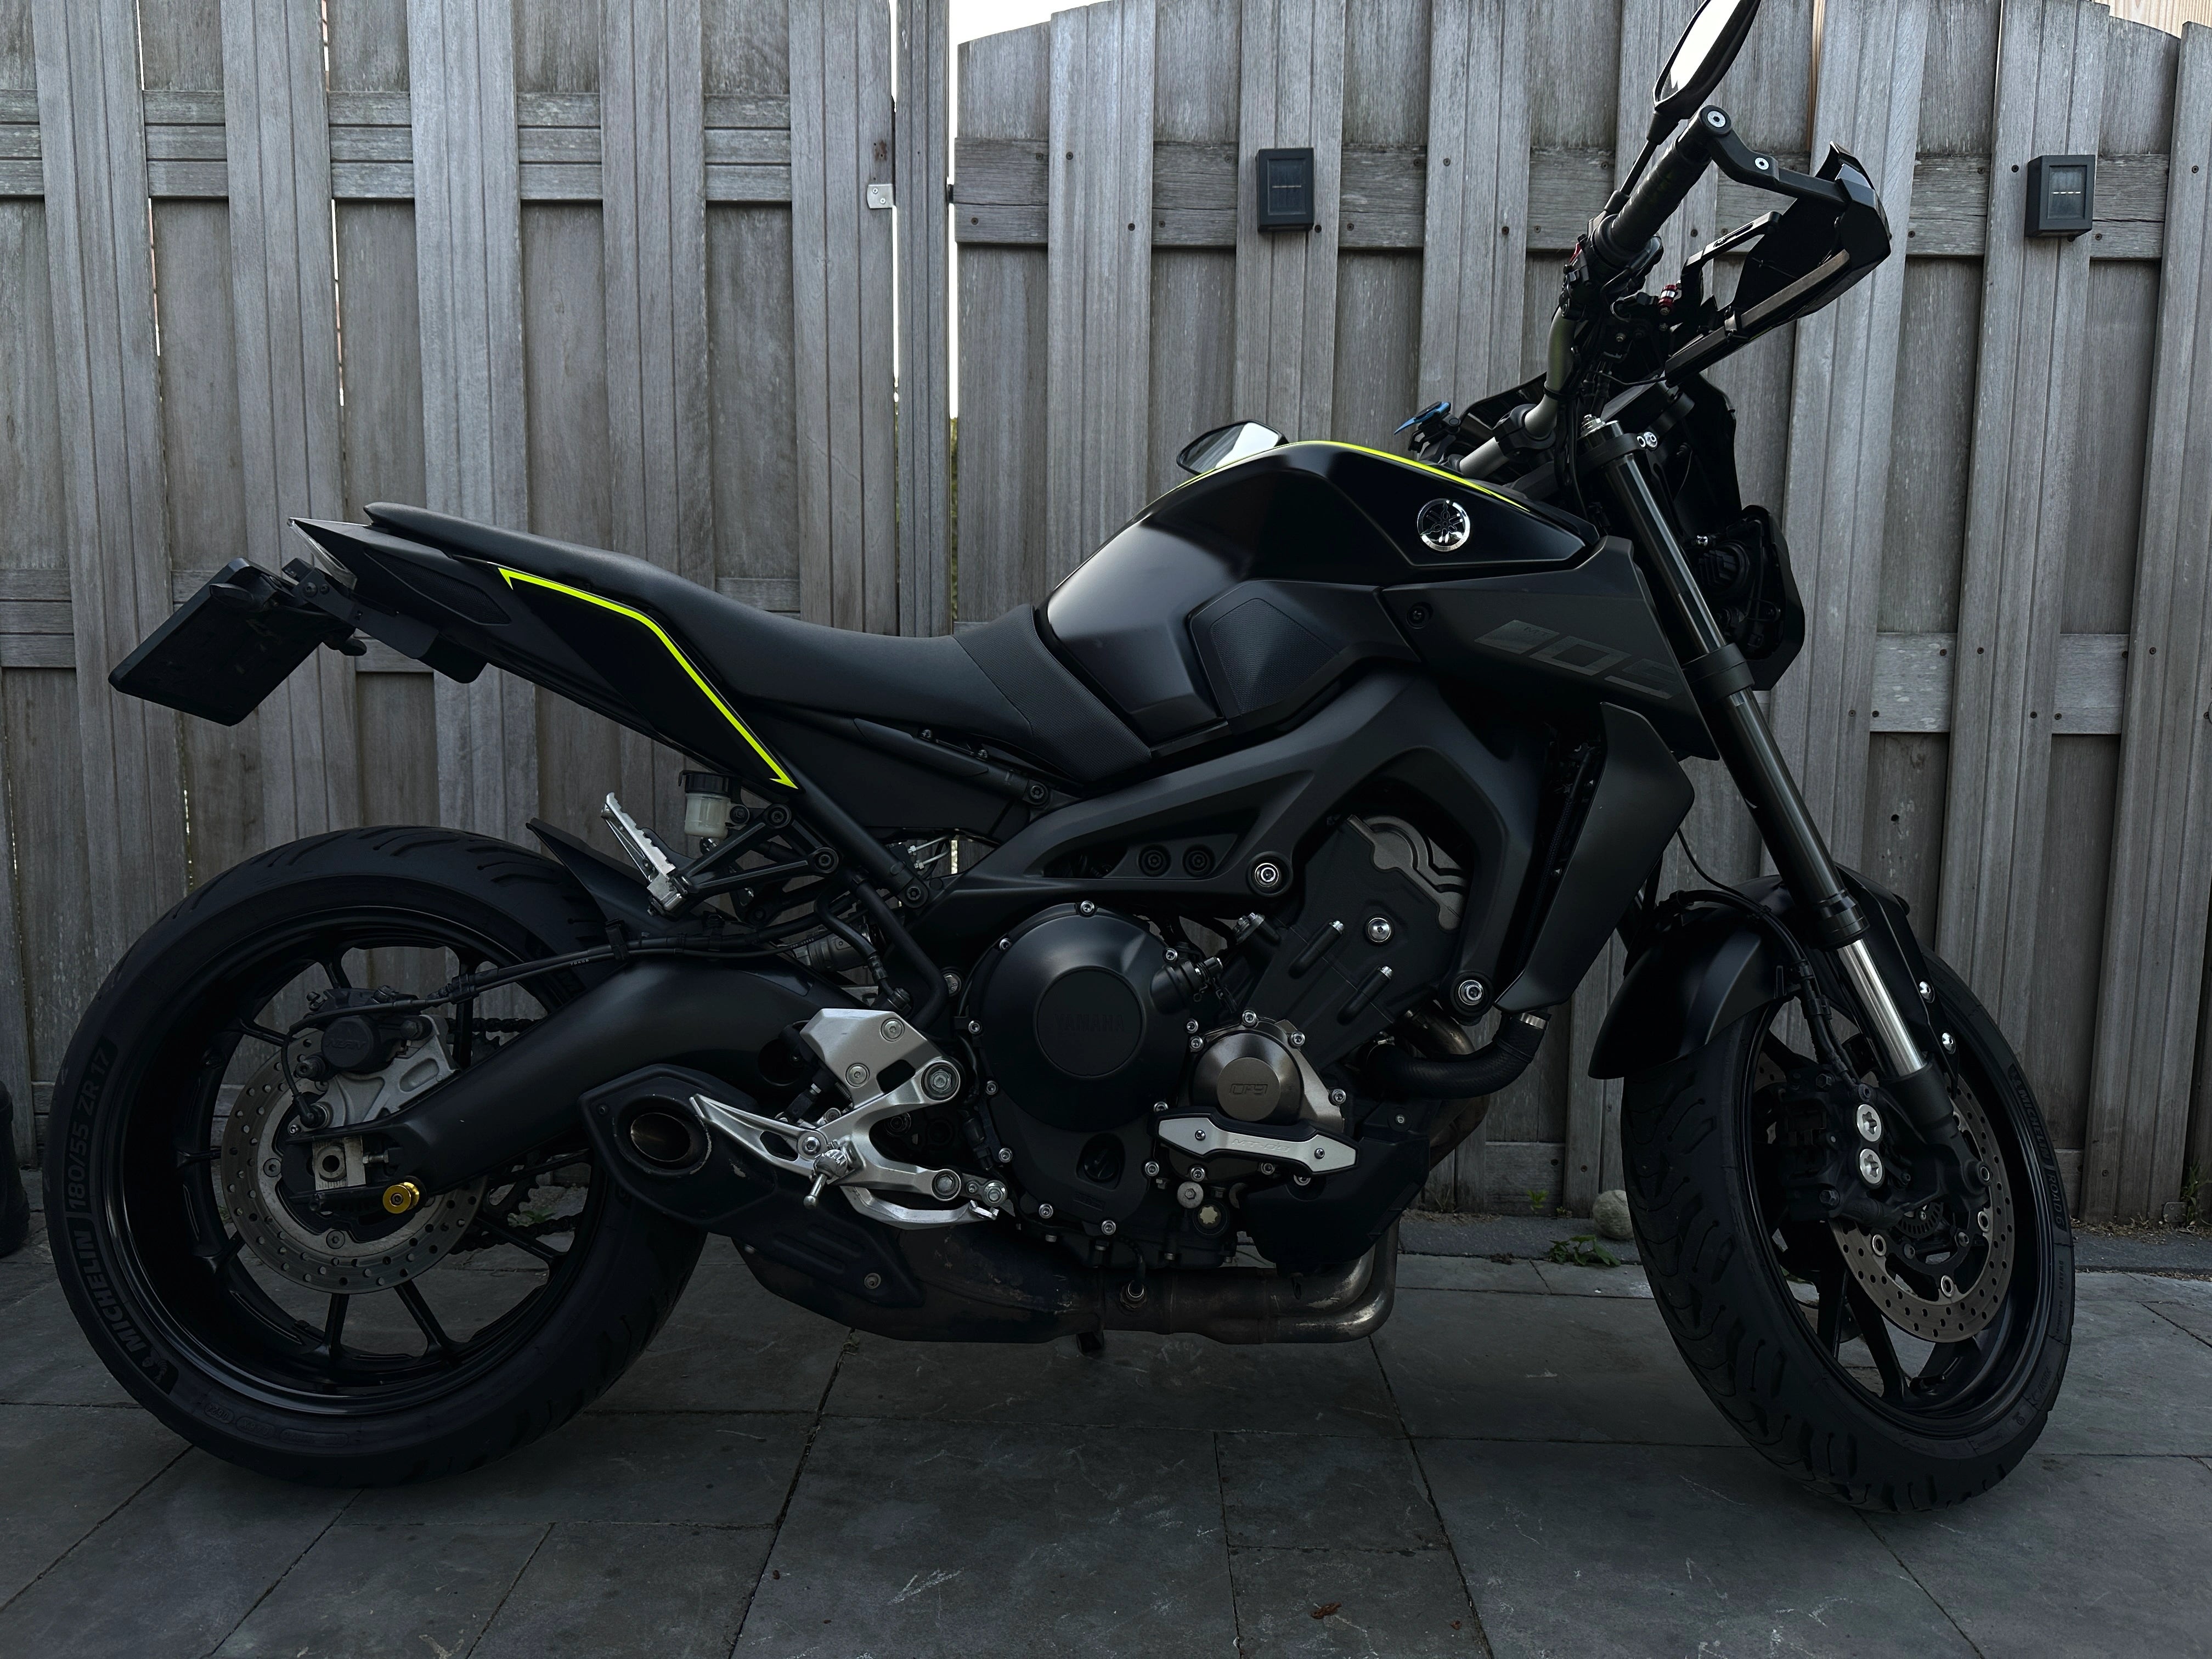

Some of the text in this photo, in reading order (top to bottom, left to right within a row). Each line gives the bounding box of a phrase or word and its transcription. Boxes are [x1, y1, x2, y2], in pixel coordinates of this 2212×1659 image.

[1053, 1013, 1125, 1031] YAMAHA
[67, 1047, 109, 1210] 180/55 ZR 17
[1232, 1138, 1290, 1153] MT-09
[2017, 1089, 2065, 1227] MICHELIN ROAD 6
[74, 1230, 146, 1353] MICHELIN
